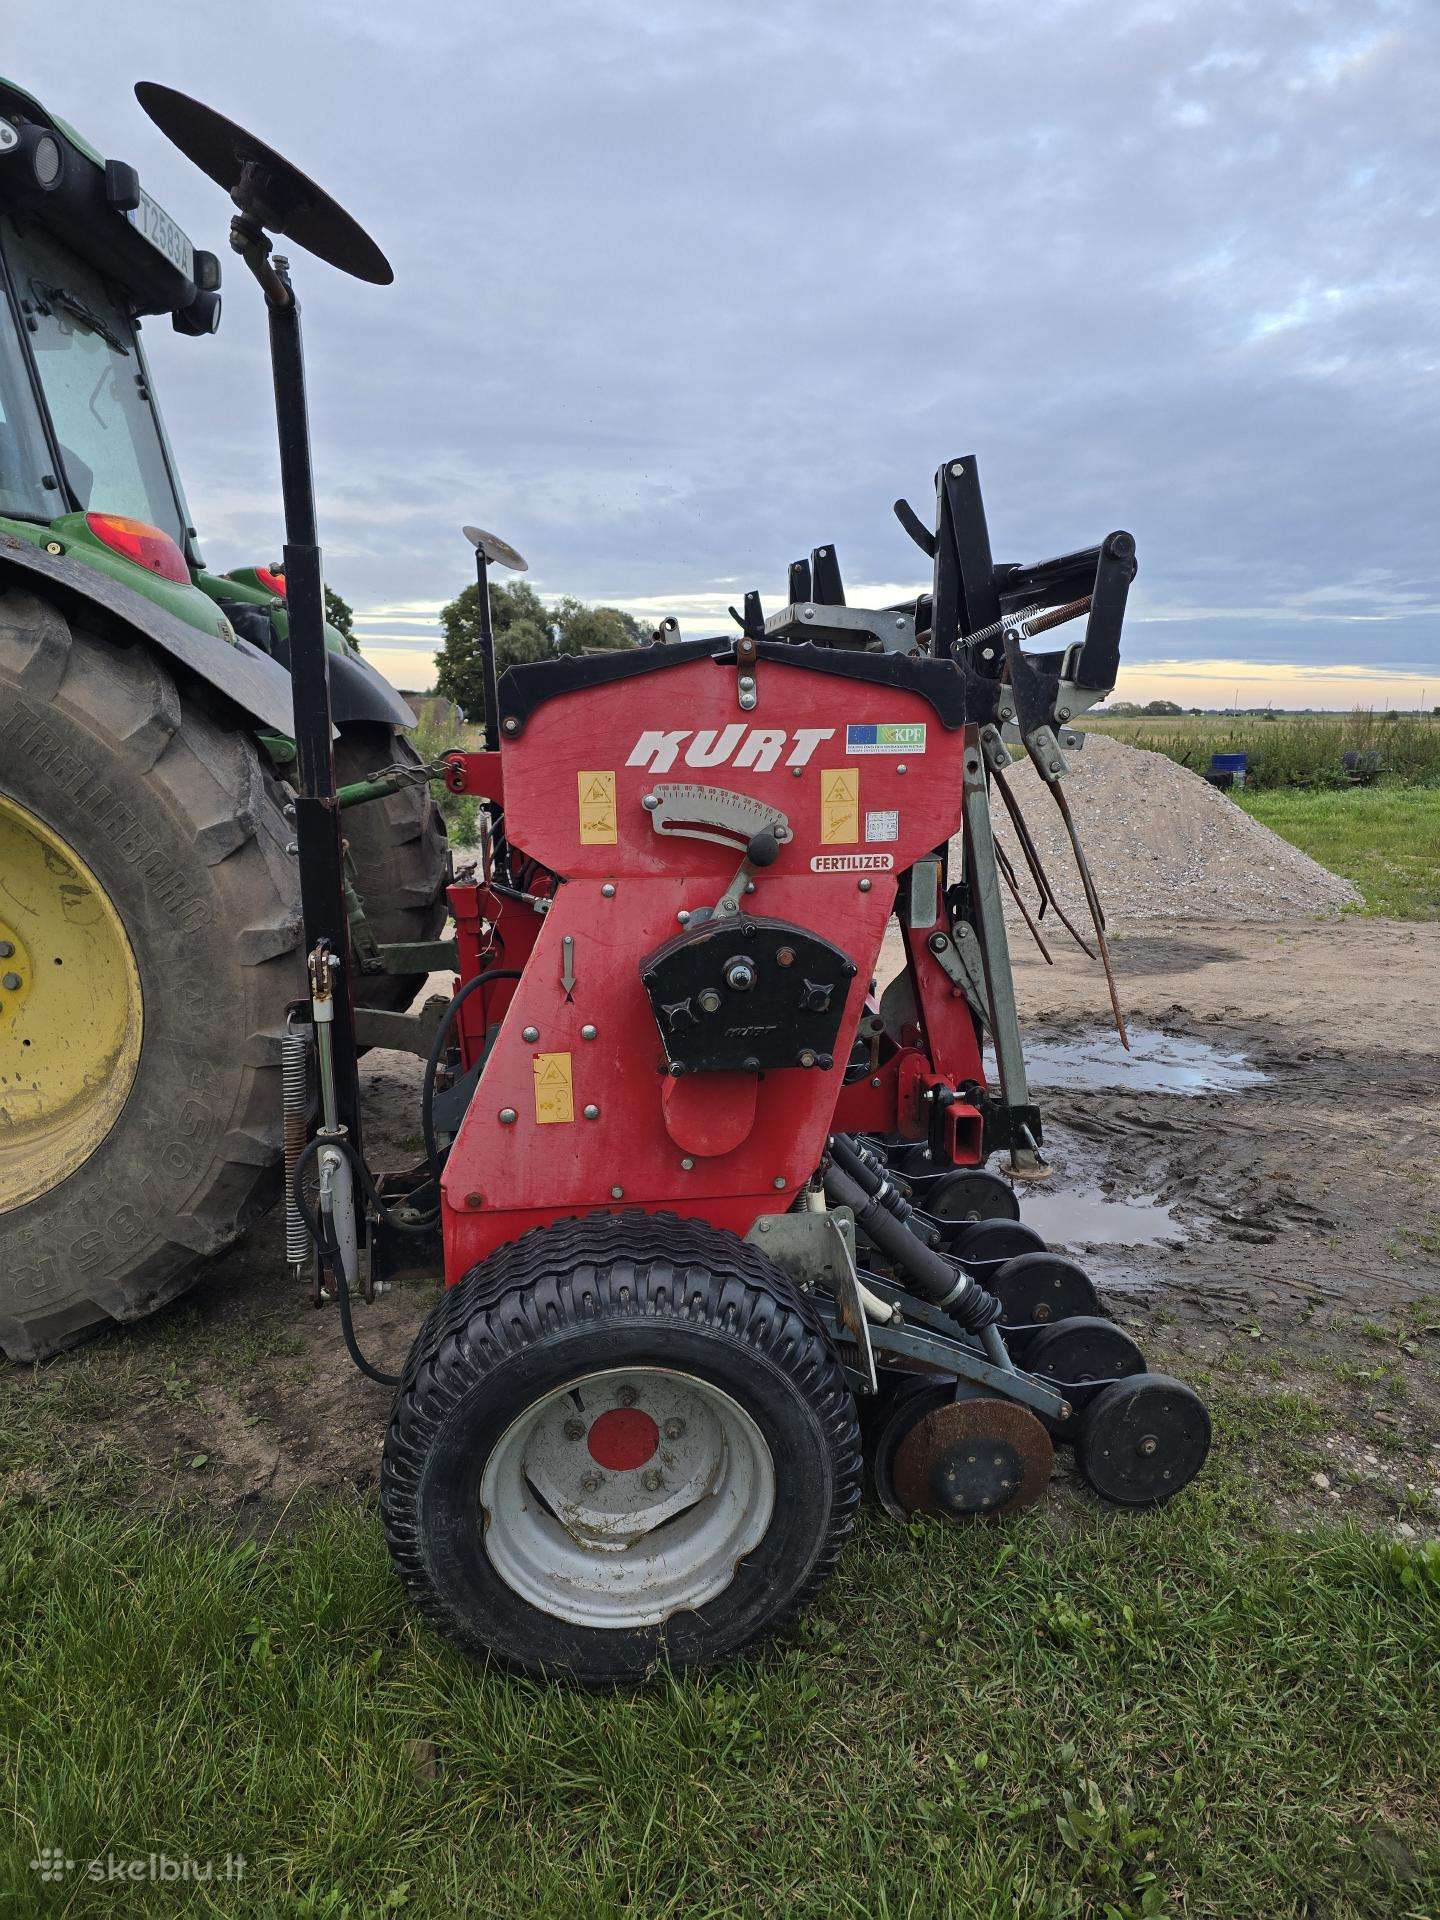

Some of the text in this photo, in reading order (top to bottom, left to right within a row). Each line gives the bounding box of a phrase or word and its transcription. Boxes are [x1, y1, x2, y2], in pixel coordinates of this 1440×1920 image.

[895, 728, 922, 742] KPF
[625, 724, 836, 773] KURT
[754, 801, 763, 810] 20
[765, 806, 774, 814] 10
[1, 700, 214, 935] TRELLEBORG
[815, 856, 889, 871] FERTILIZER
